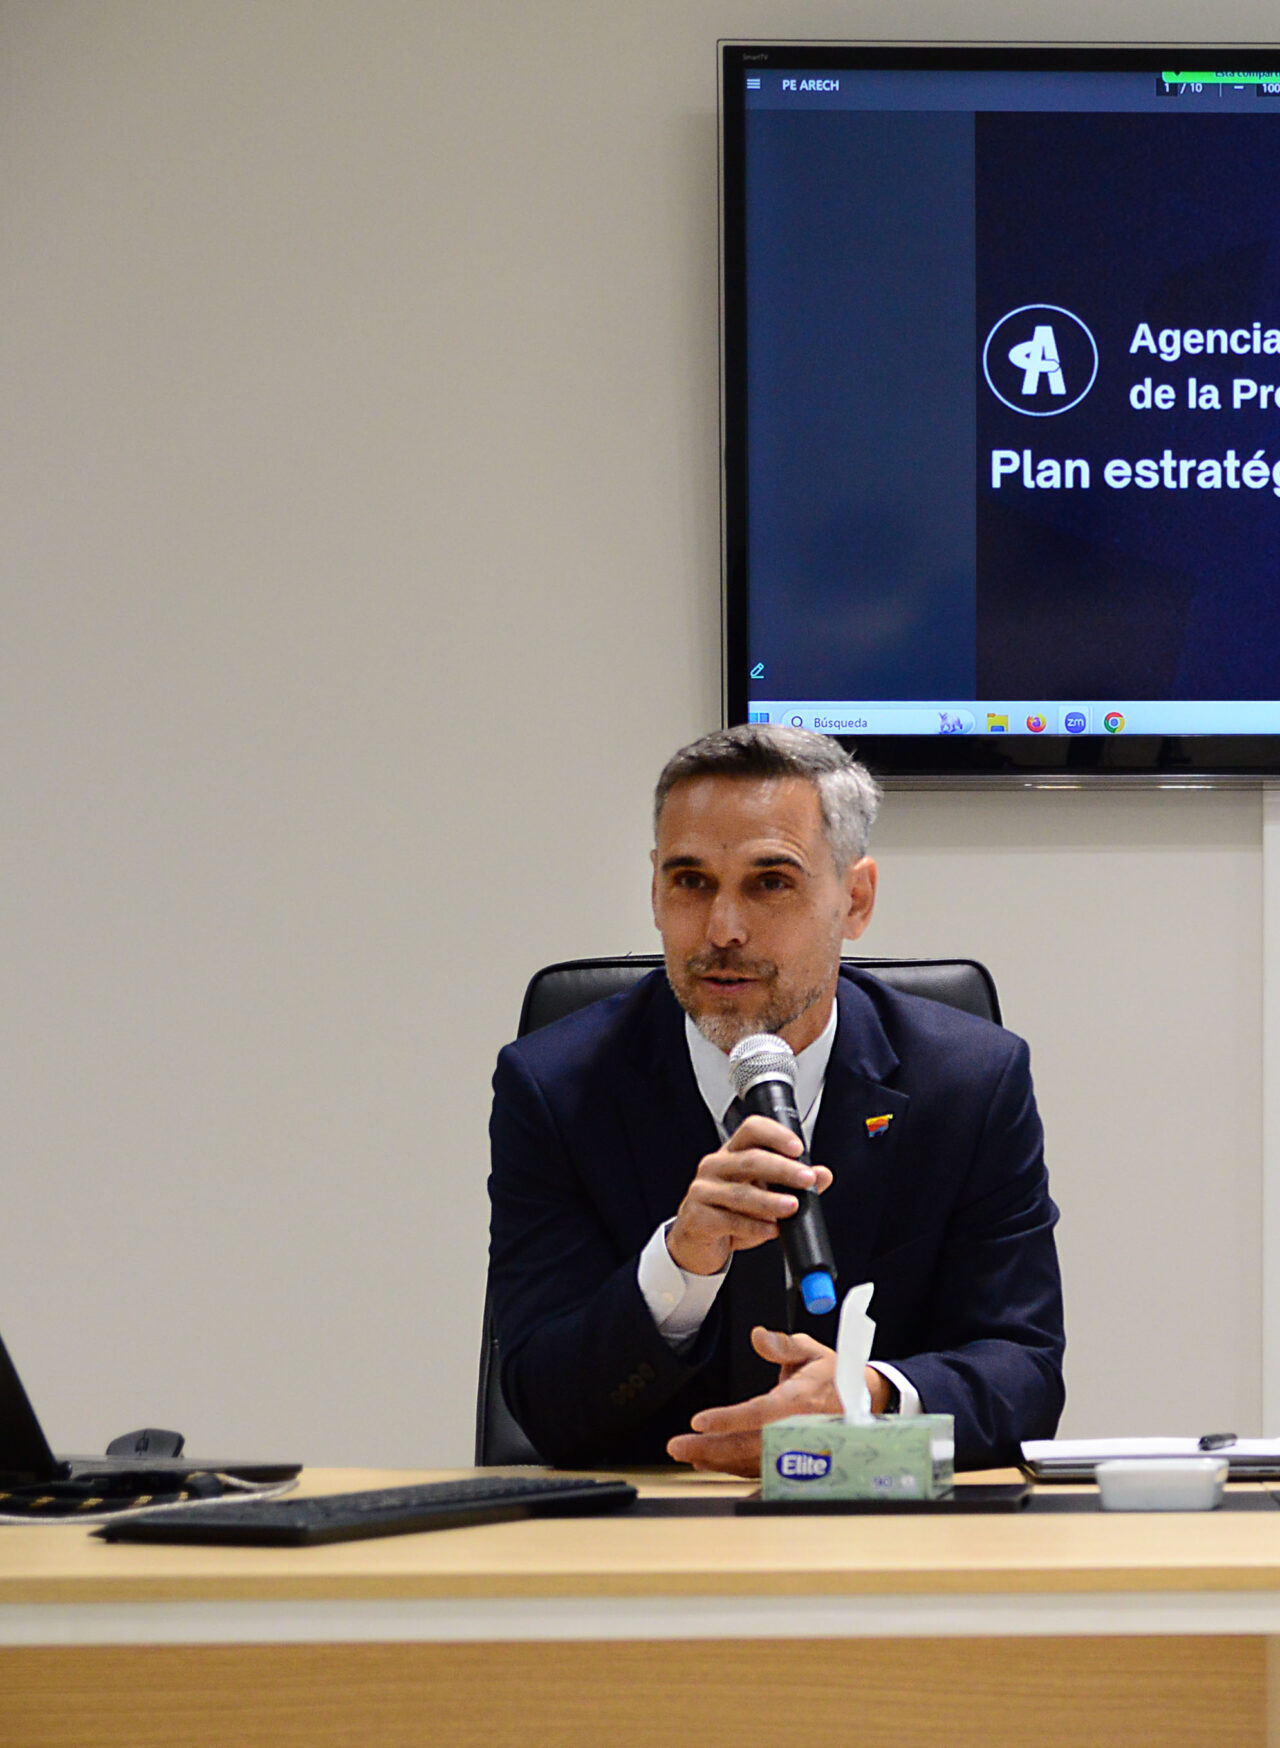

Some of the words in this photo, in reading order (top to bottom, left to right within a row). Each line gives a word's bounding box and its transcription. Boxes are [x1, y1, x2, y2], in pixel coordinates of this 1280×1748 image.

[782, 79, 797, 91] PE
[799, 79, 840, 91] ARECH
[1164, 83, 1170, 93] 1
[1190, 83, 1203, 93] 10
[1129, 377, 1175, 410] de
[1188, 377, 1220, 410] la
[991, 449, 1089, 489] Plan
[813, 717, 868, 730] Búsqueda
[782, 1455, 828, 1475] Elite
